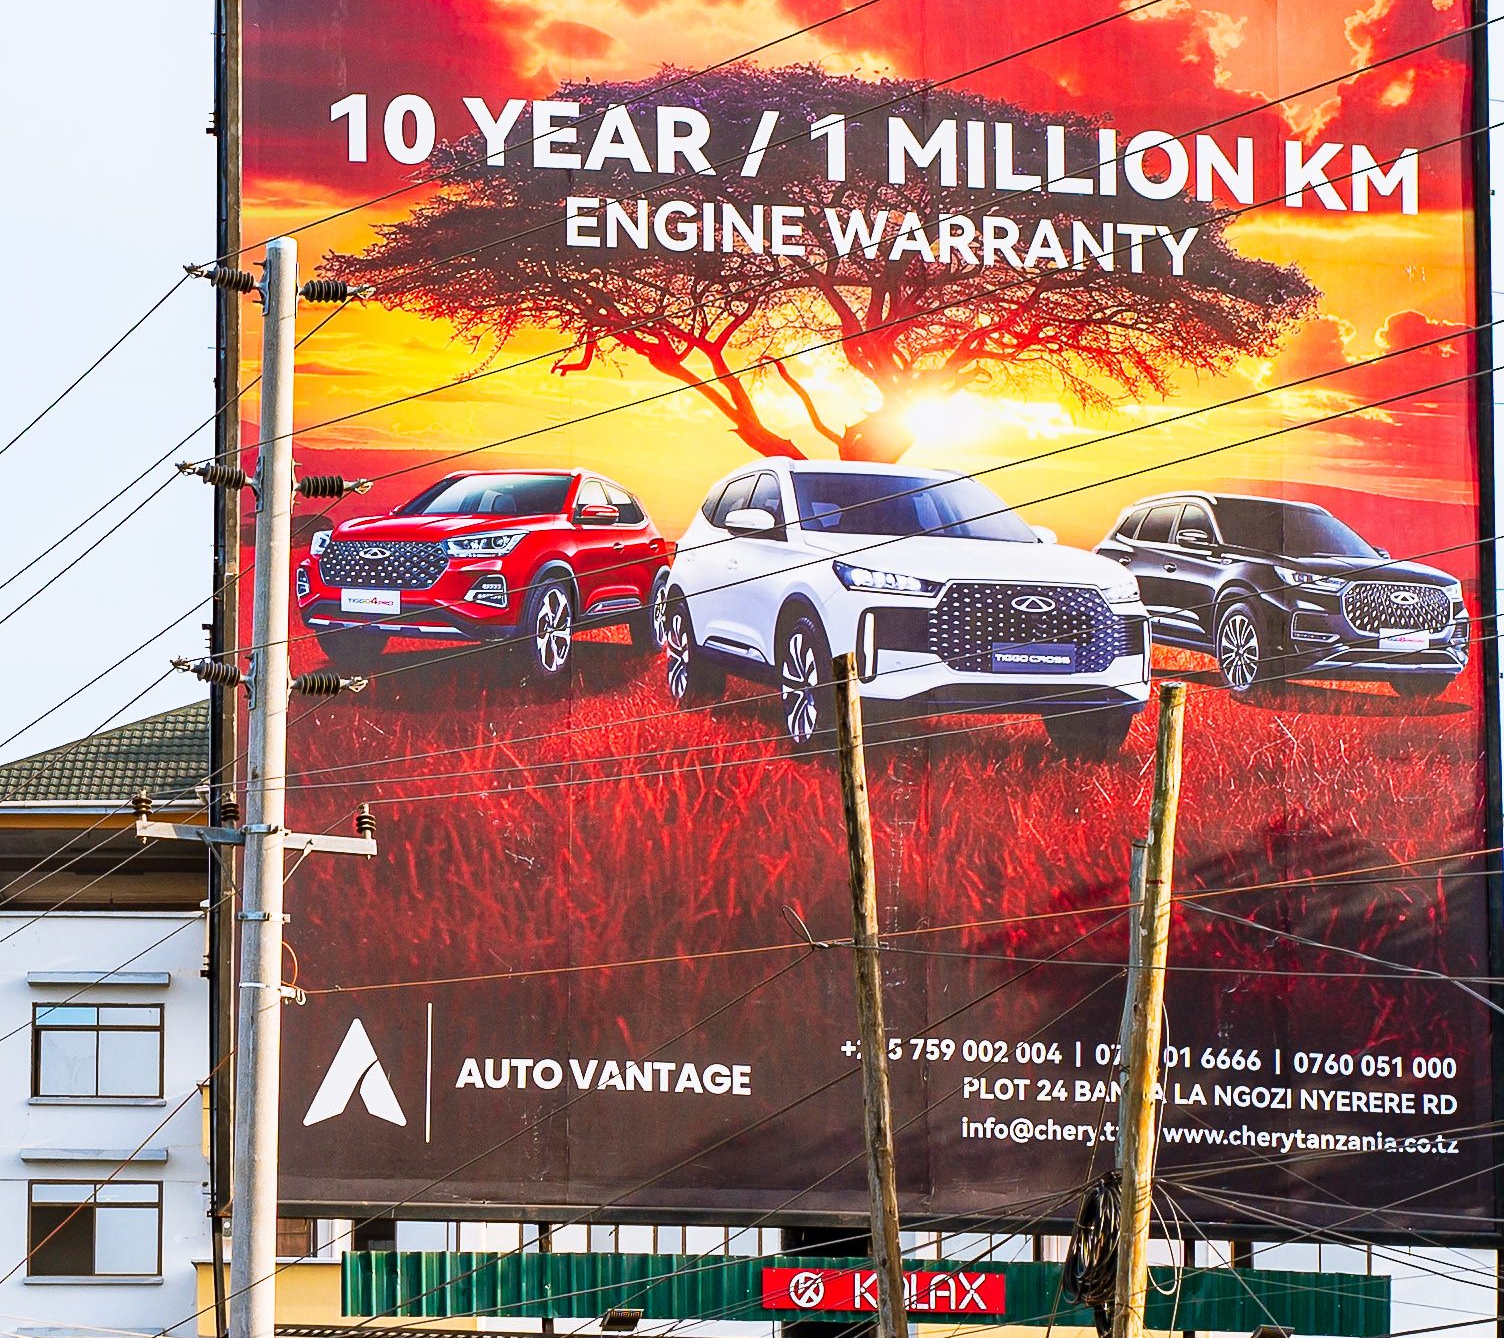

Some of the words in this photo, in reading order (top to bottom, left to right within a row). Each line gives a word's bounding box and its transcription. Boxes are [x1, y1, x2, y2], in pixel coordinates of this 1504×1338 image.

[329, 93, 437, 165] 10
[463, 97, 717, 176] YEAR
[740, 109, 781, 179] /
[809, 113, 847, 182] 1
[887, 115, 1256, 205] MILLION
[1284, 139, 1419, 215] KM
[565, 196, 807, 257] ENGINE
[823, 206, 1200, 277] WARRANTY
[455, 1057, 563, 1090] AUTO
[568, 1059, 752, 1096] VANTAGE
[909, 1038, 956, 1061] 759
[962, 1040, 1009, 1063] 002
[1016, 1041, 1062, 1065] 004
[1201, 1047, 1262, 1071] 6666
[1293, 1051, 1354, 1076] 0760
[1360, 1054, 1403, 1078] 051
[1412, 1057, 1458, 1079] 000
[963, 1076, 1032, 1101] PLOT
[1036, 1080, 1068, 1102] 24
[1174, 1083, 1207, 1106] LA
[1214, 1085, 1292, 1109] NGOZI
[1300, 1089, 1416, 1114] NYERERE
[1423, 1094, 1458, 1115] RD
[1162, 1125, 1459, 1154] www.cherytanzania.co.tz
[854, 1272, 987, 1311] KLAX
